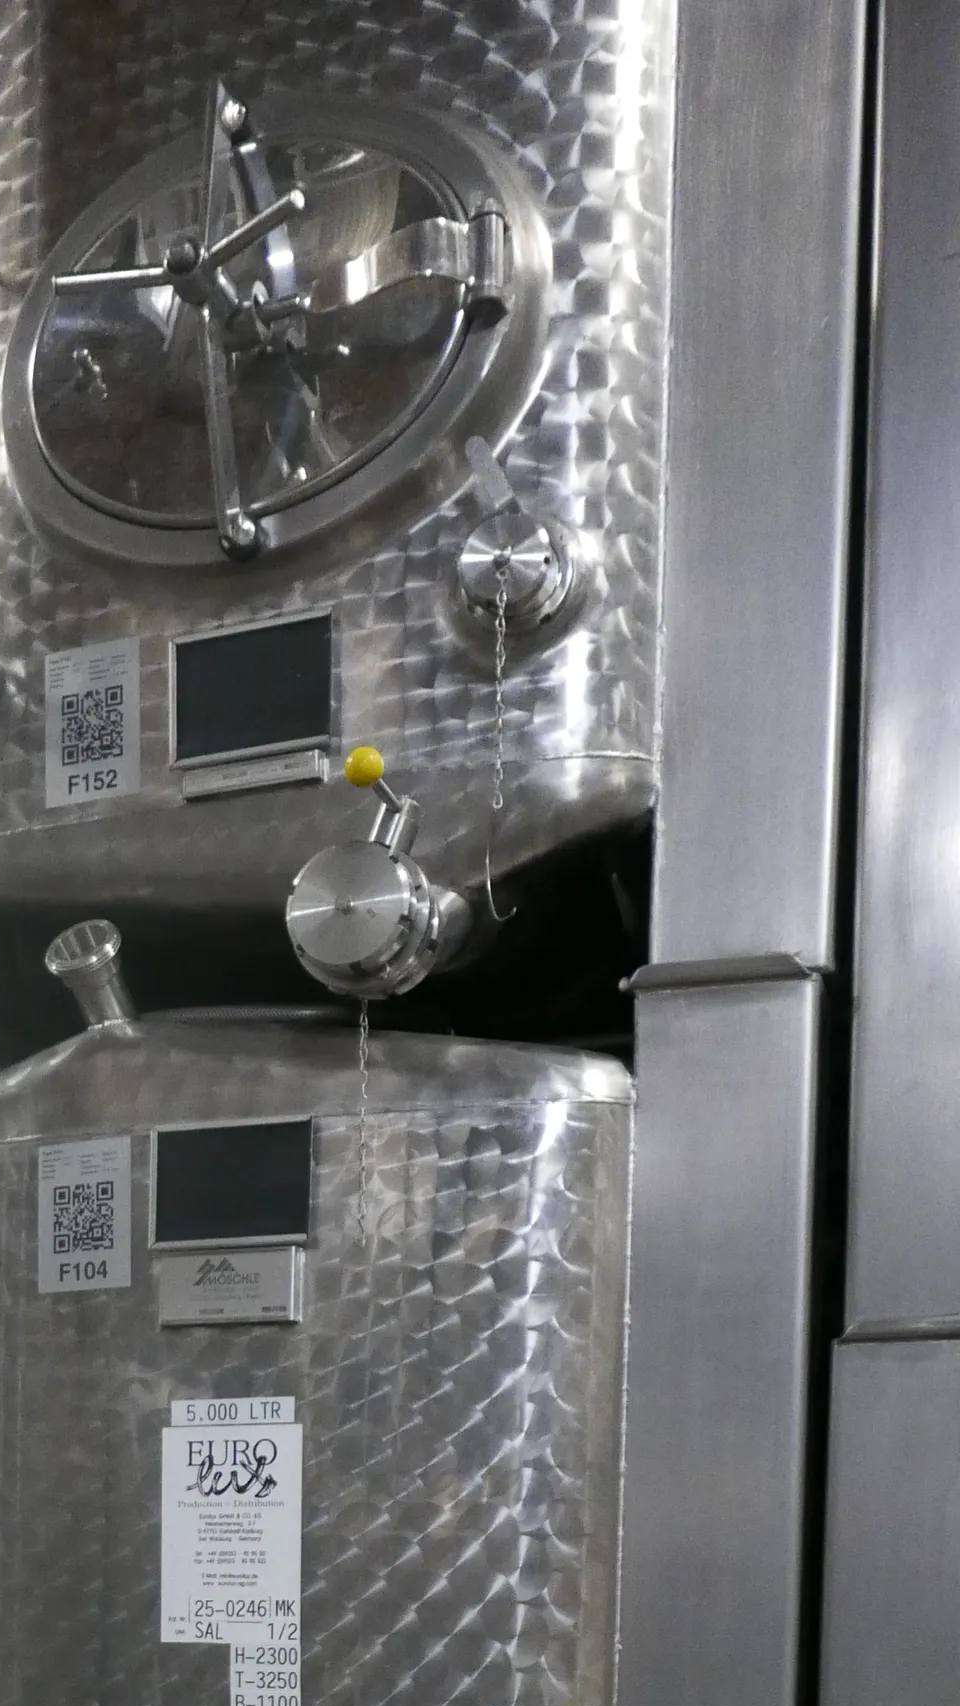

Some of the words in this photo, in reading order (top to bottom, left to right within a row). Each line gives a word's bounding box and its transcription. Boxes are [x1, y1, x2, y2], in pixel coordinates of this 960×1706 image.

[67, 769, 118, 795] F152
[58, 1259, 108, 1281] F104
[186, 1402, 238, 1421] 5.000
[249, 1401, 281, 1420] LTR
[187, 1438, 277, 1466] EURO
[194, 1599, 268, 1618] 25-0246
[275, 1599, 296, 1616] MK
[195, 1621, 224, 1641] SAL
[267, 1622, 298, 1641] 1/2
[235, 1647, 298, 1666] H-2300
[235, 1671, 298, 1690] T-3250
